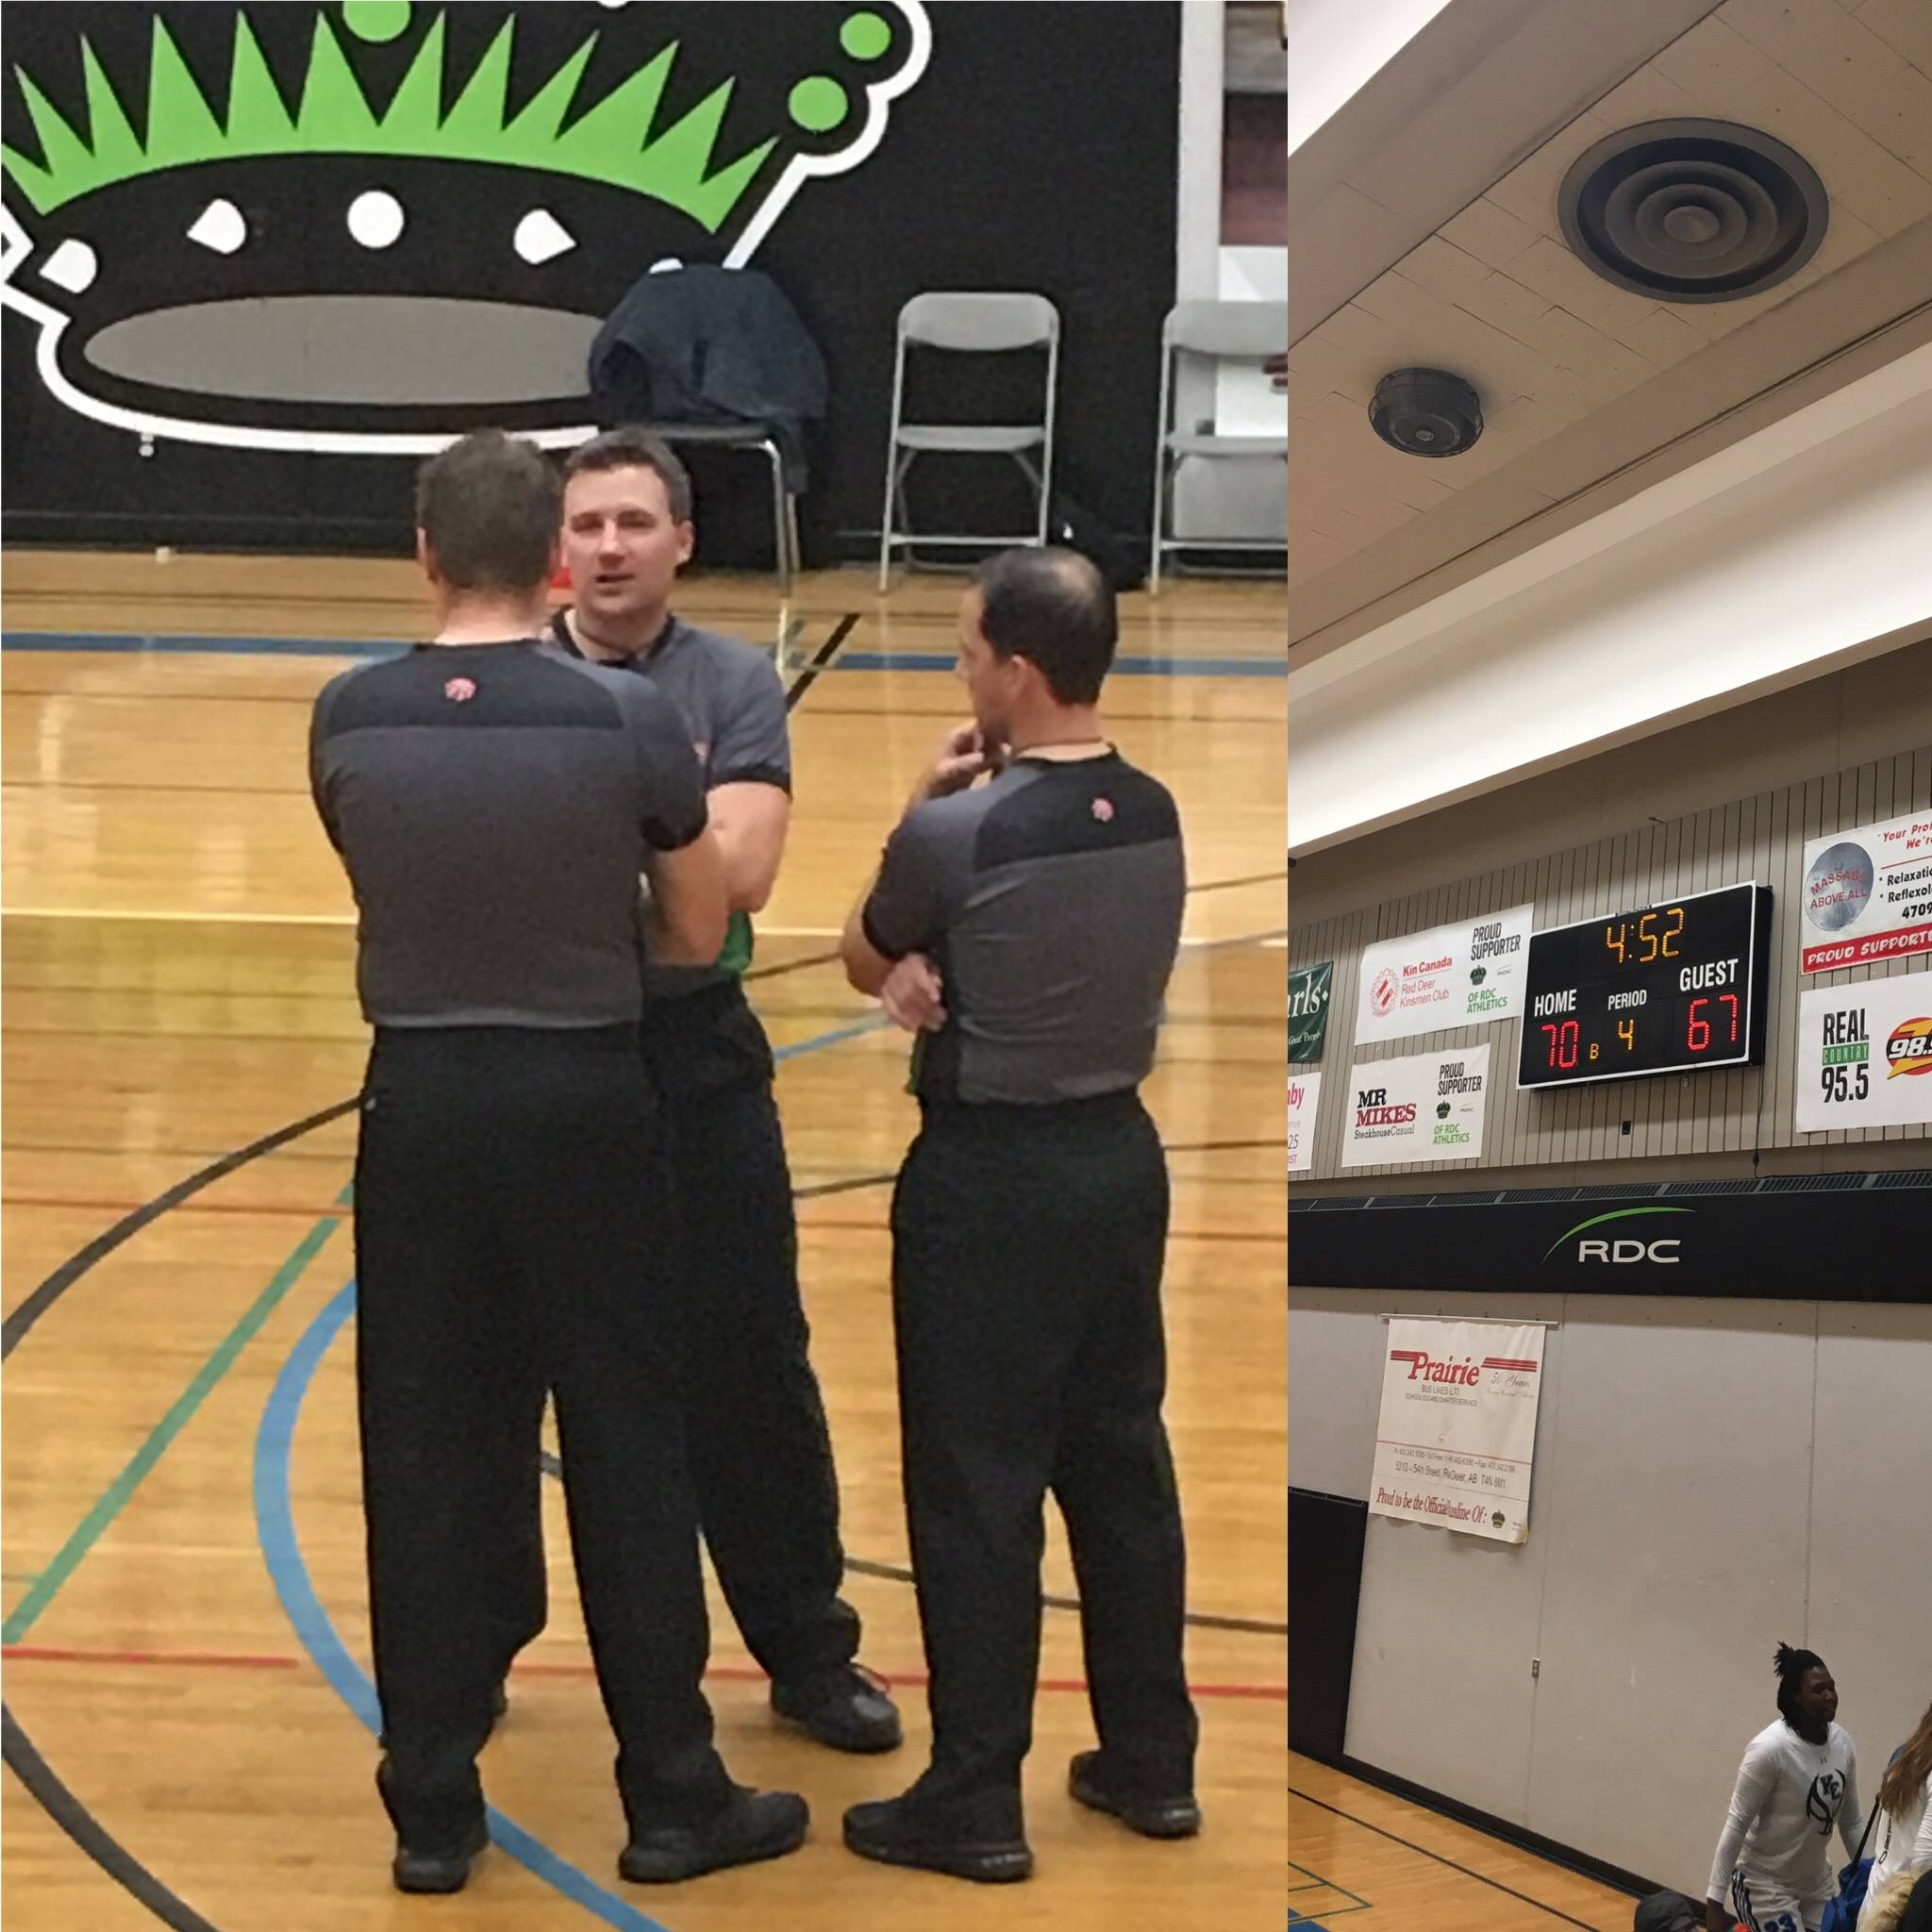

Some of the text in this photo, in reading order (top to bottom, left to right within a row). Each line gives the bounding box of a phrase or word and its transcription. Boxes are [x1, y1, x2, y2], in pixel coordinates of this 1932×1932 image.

[1883, 830, 1907, 842] Your
[1810, 870, 1868, 896] MASSAGE
[1810, 890, 1867, 909] ABOVE ALL
[1888, 884, 1932, 903] Reflexol
[1473, 922, 1503, 943] PROUD
[1607, 908, 1685, 963] 4:52
[1471, 934, 1522, 961] SUPPORTER
[1807, 946, 1855, 965] PROUD
[1403, 956, 1453, 976] Kin Canada
[1679, 958, 1739, 991] GUEST
[1402, 979, 1436, 995] Red Deer
[1468, 988, 1496, 1003] OF RDC
[1400, 989, 1450, 1008] Kinsmen Club
[1466, 996, 1507, 1014] ATHLETICS
[1534, 989, 1577, 1017] HOME
[1607, 990, 1647, 1010] PERIOD
[1688, 993, 1738, 1051] 67
[1823, 1008, 1870, 1045] REAL
[1541, 1020, 1579, 1068] 70
[1618, 1019, 1634, 1051] 4
[1824, 1045, 1868, 1064] COUNTRY
[1440, 1062, 1465, 1080] PROUD
[1438, 1075, 1482, 1096] SUPPORTER
[1822, 1063, 1869, 1103] 95.5
[1357, 1088, 1387, 1108] MR
[1356, 1103, 1417, 1127] MIKES
[1433, 1132, 1470, 1145] ATHLETICS
[1434, 1124, 1460, 1136] OF RDC
[1578, 1240, 1681, 1263] RDC
[1407, 1352, 1480, 1387] Prairie
[1468, 1474, 1478, 1484] AB
[1376, 1487, 1396, 1506] Proud
[1395, 1493, 1402, 1507] to
[1403, 1491, 1412, 1508] be
[1413, 1494, 1424, 1510] the
